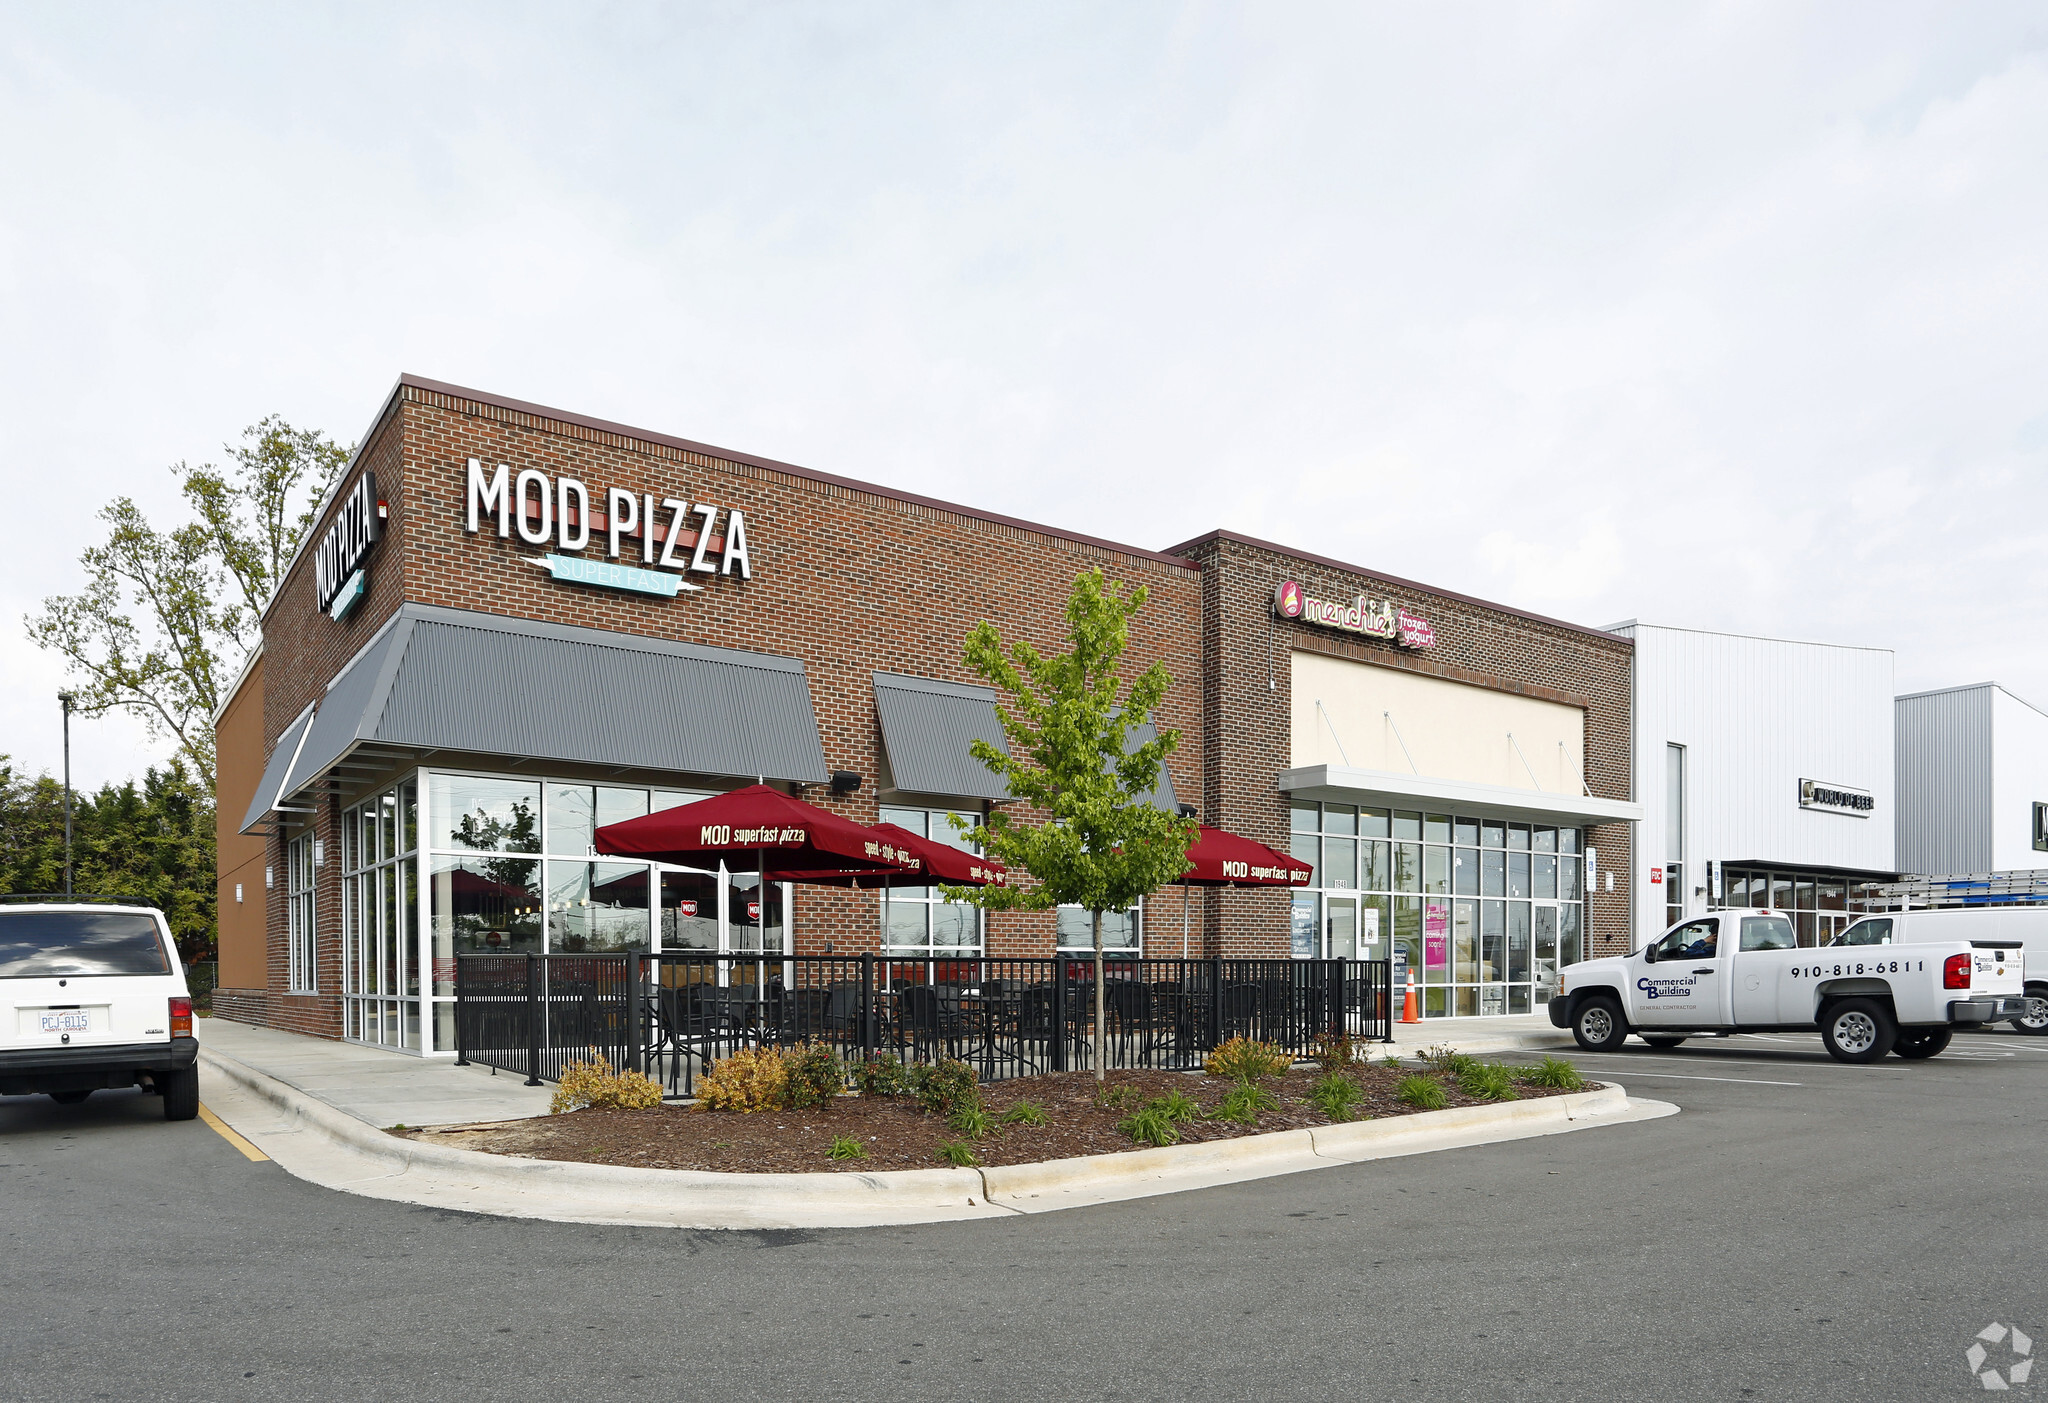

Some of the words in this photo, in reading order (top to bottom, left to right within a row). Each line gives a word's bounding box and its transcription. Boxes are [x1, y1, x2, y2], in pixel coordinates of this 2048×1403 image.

[467, 457, 590, 551] MOD
[608, 486, 751, 580] PIZZA
[315, 525, 338, 613] MOD
[338, 472, 371, 582] PIZZA
[560, 559, 621, 584] SUPER
[627, 570, 671, 592] FAST
[1305, 595, 1397, 639] menchie's
[1399, 610, 1428, 633] frozen
[1404, 630, 1434, 646] yogurt
[1818, 788, 1844, 805] WORLD
[1845, 792, 1855, 806] OF
[1857, 794, 1875, 810] BEER
[701, 825, 731, 846] MOD
[733, 825, 779, 846] superfast
[779, 825, 805, 845] pizza
[864, 840, 880, 858] speed
[882, 843, 894, 862] style
[1222, 860, 1248, 878] MOD
[1250, 865, 1288, 881] superfast
[1290, 868, 1309, 883] pizza
[1651, 871, 1661, 881] FDC
[682, 903, 696, 912] MOD
[1791, 961, 1923, 978] 910-818-6811
[1637, 975, 1697, 991] Commercial
[1647, 985, 1691, 999] Building
[42, 1015, 88, 1029] PCJ-8115
